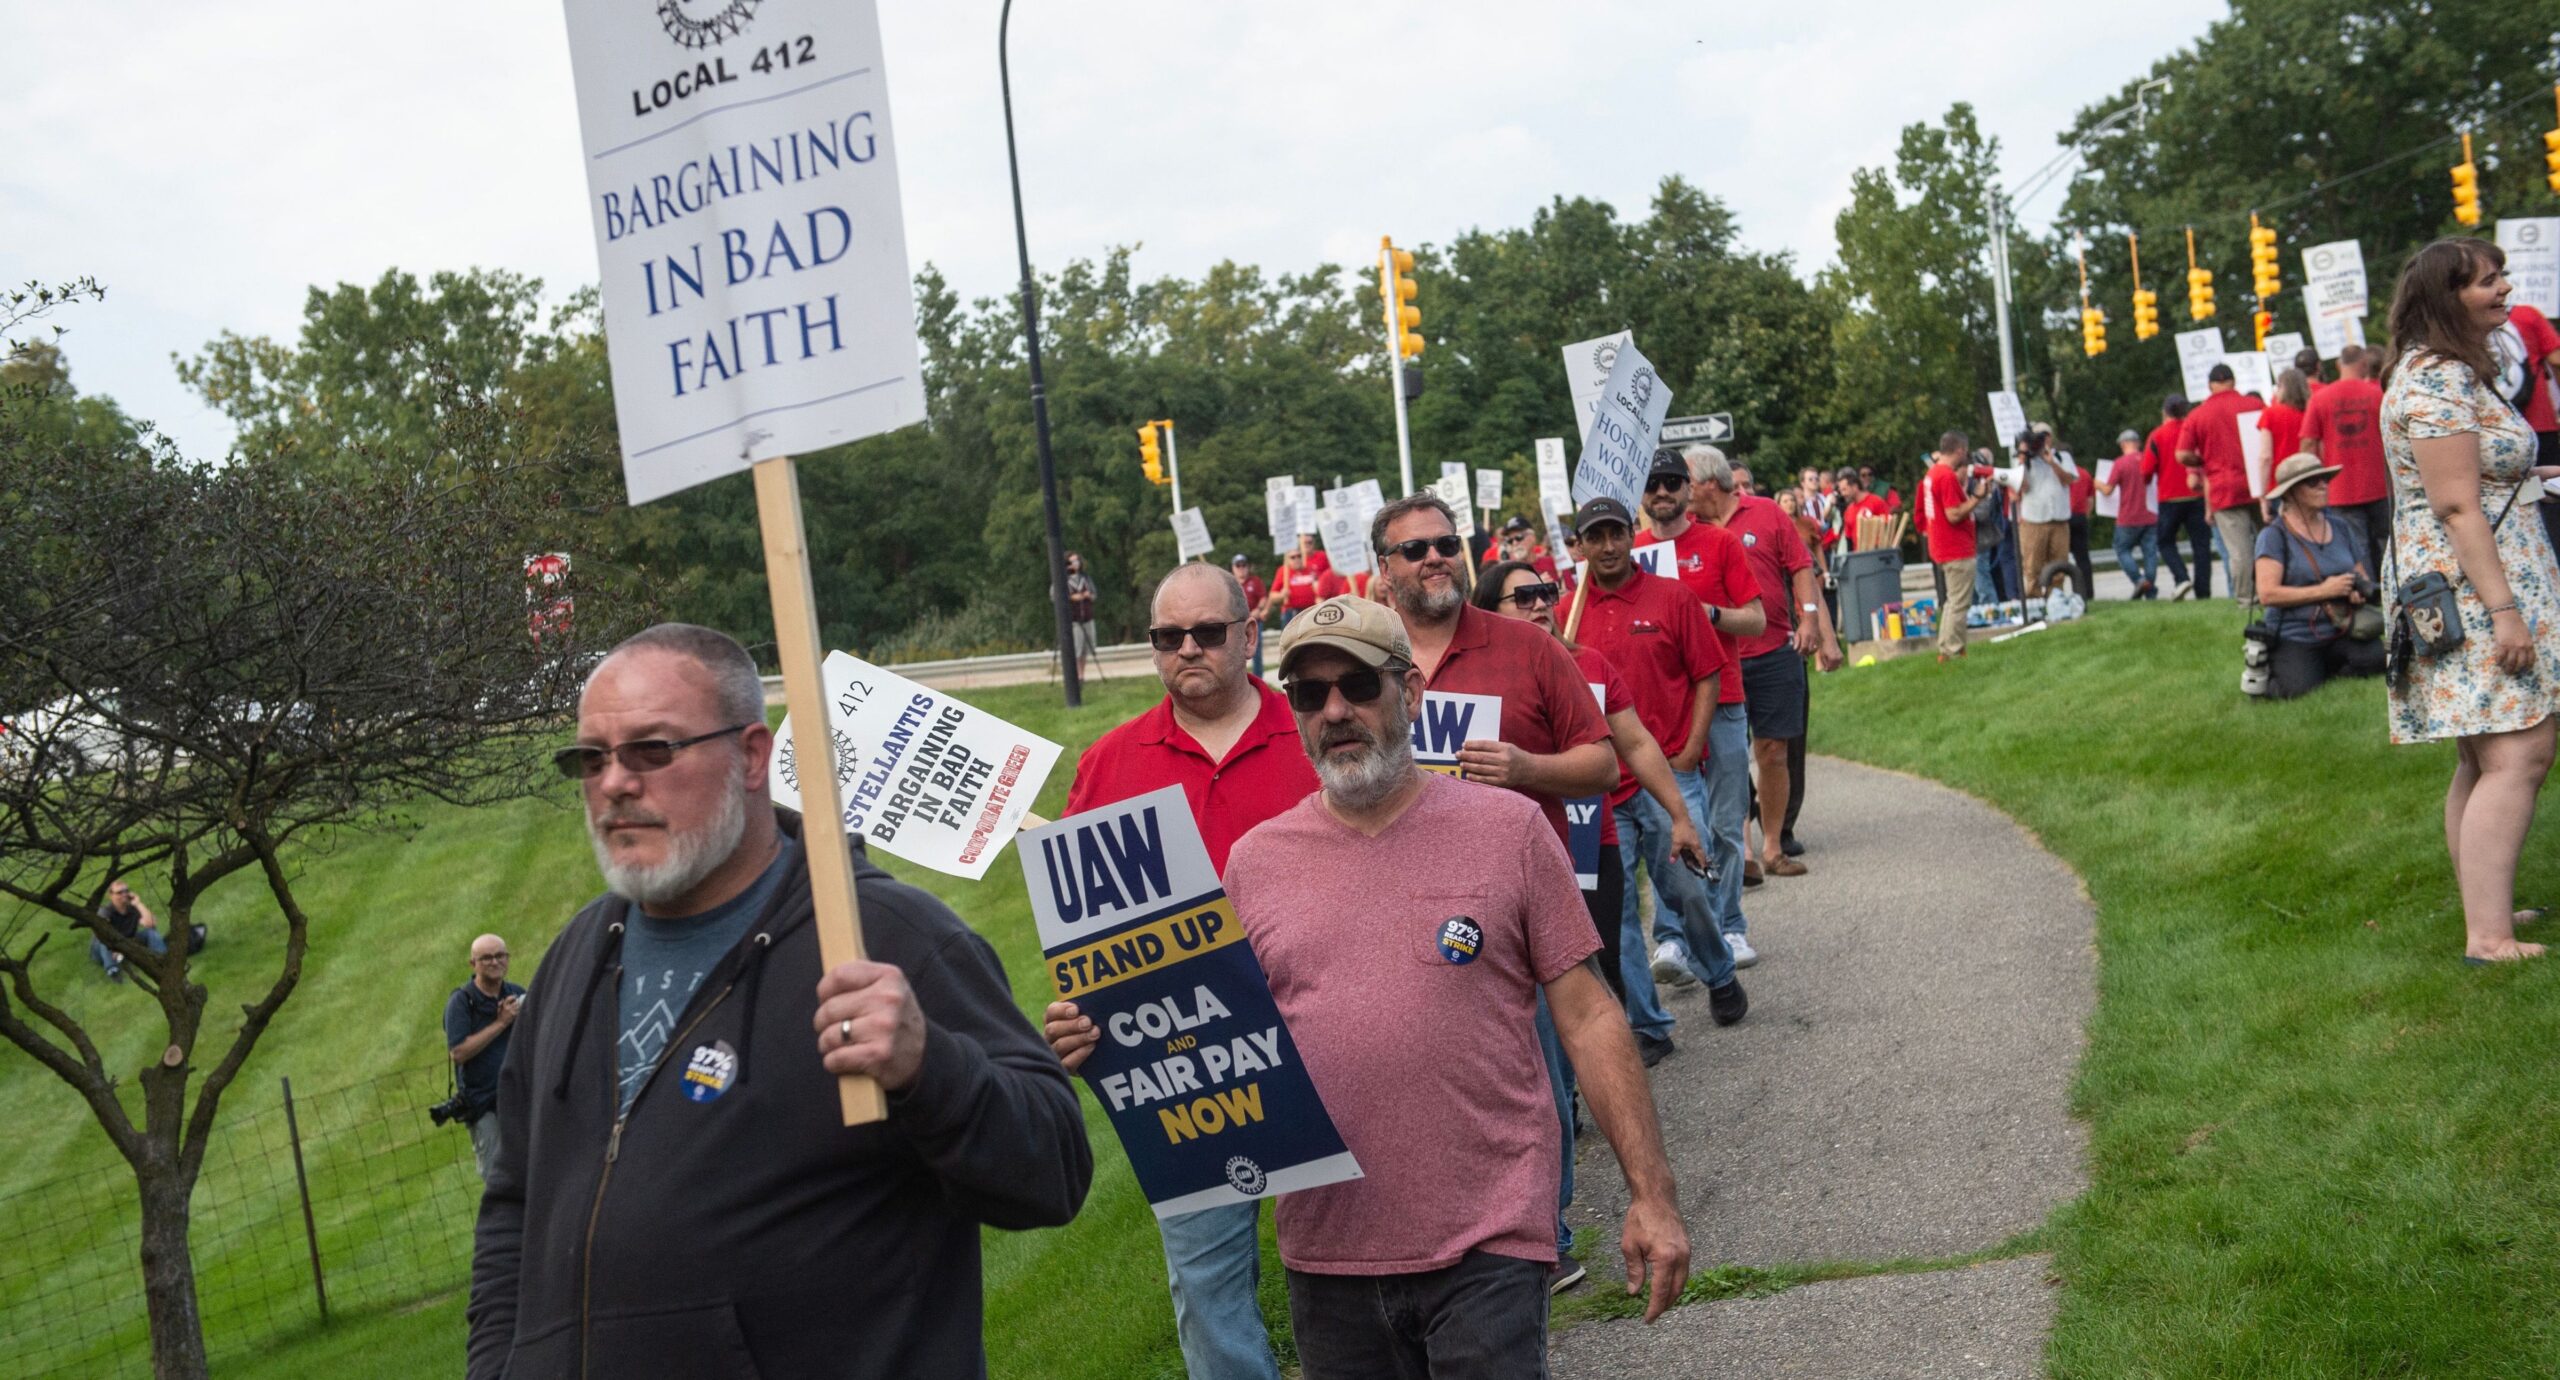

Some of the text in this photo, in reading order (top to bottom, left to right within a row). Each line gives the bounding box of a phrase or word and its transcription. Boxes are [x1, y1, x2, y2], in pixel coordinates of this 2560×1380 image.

[632, 34, 816, 116] LOCAL 412
[602, 111, 878, 242] BARGAINING
[640, 205, 853, 316] IN BAD
[666, 294, 847, 397] FAITH
[1615, 392, 1642, 422] LOCAL
[1597, 412, 1649, 476] HOSTILE
[1599, 443, 1639, 495] WORK
[838, 680, 873, 717] 412
[843, 693, 934, 829] STELLANTIS
[871, 705, 965, 843] BARGAINING
[912, 743, 972, 823] IN BAD
[938, 757, 994, 831] FAITH
[958, 744, 1031, 865] CORPORATE GREED
[1566, 804, 1598, 825] AY
[1041, 806, 1172, 924] UAW
[1056, 911, 1223, 994] STAND UP
[1442, 938, 1474, 956] STRIKE
[1444, 931, 1477, 948] READY TO
[1447, 920, 1479, 941] 97%
[1108, 984, 1231, 1048] COLA
[1167, 1035, 1196, 1054] AND
[692, 1045, 734, 1070] 97%
[1100, 1026, 1283, 1112] FAIR PAY
[1158, 1082, 1265, 1145] NOW
